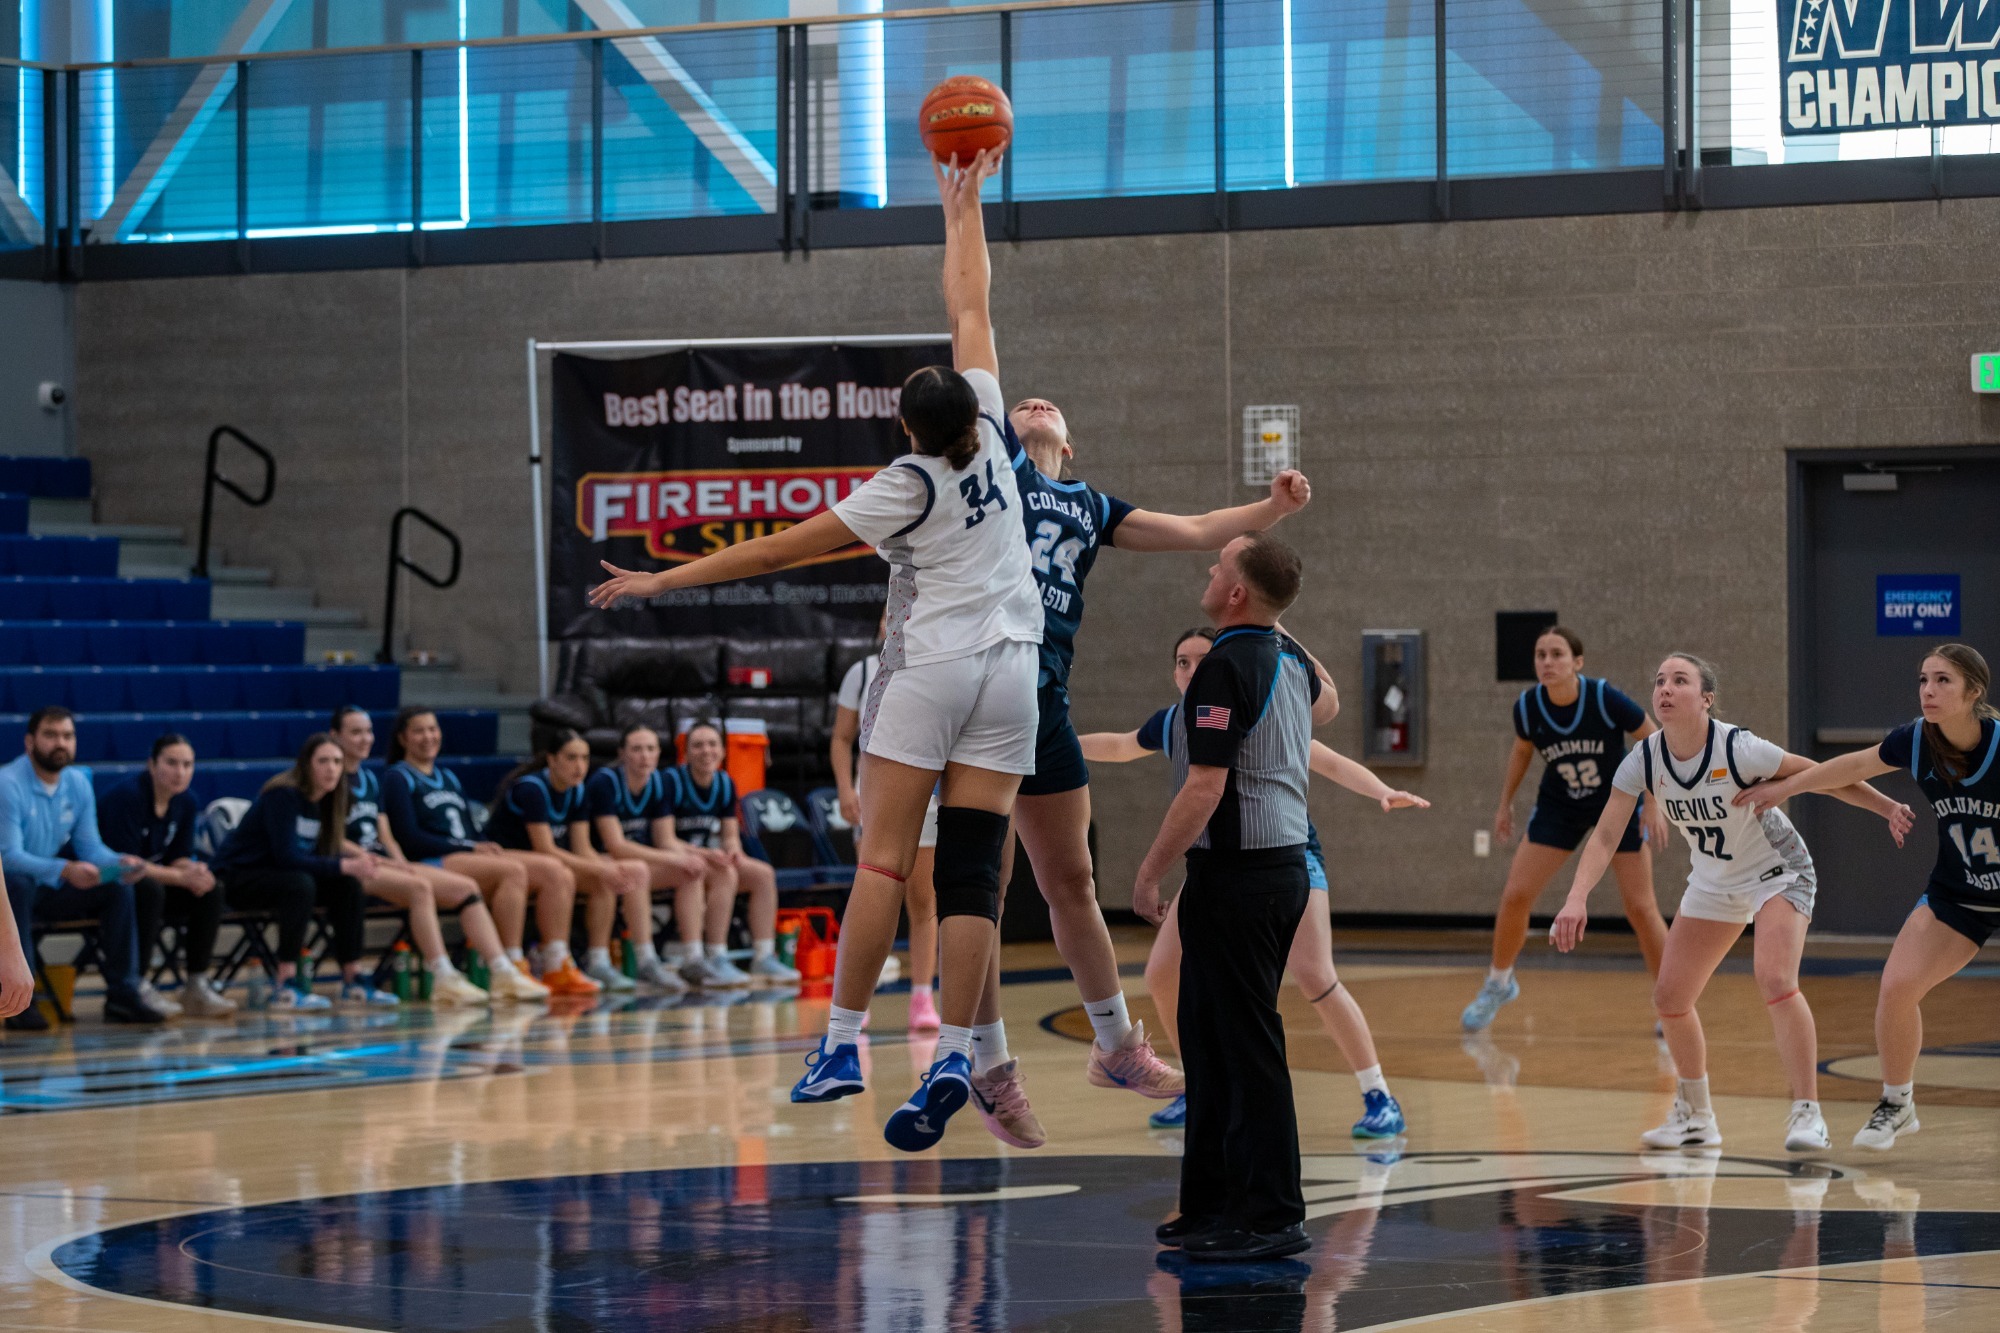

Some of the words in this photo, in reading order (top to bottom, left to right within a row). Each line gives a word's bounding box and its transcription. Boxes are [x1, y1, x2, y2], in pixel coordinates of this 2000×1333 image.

[603, 388, 669, 427] Best
[673, 384, 737, 423] Seat
[743, 382, 773, 421] in
[779, 382, 831, 420] the
[787, 436, 802, 453] by
[959, 458, 1008, 530] 34
[1030, 519, 1087, 586] 24
[1884, 590, 1952, 603] EMERGENCY
[1885, 603, 1914, 618] EXIT
[1917, 603, 1952, 618] ONLY
[1666, 795, 1728, 821] DEVILS
[1686, 826, 1733, 861] 22
[1948, 822, 2000, 868] 14
